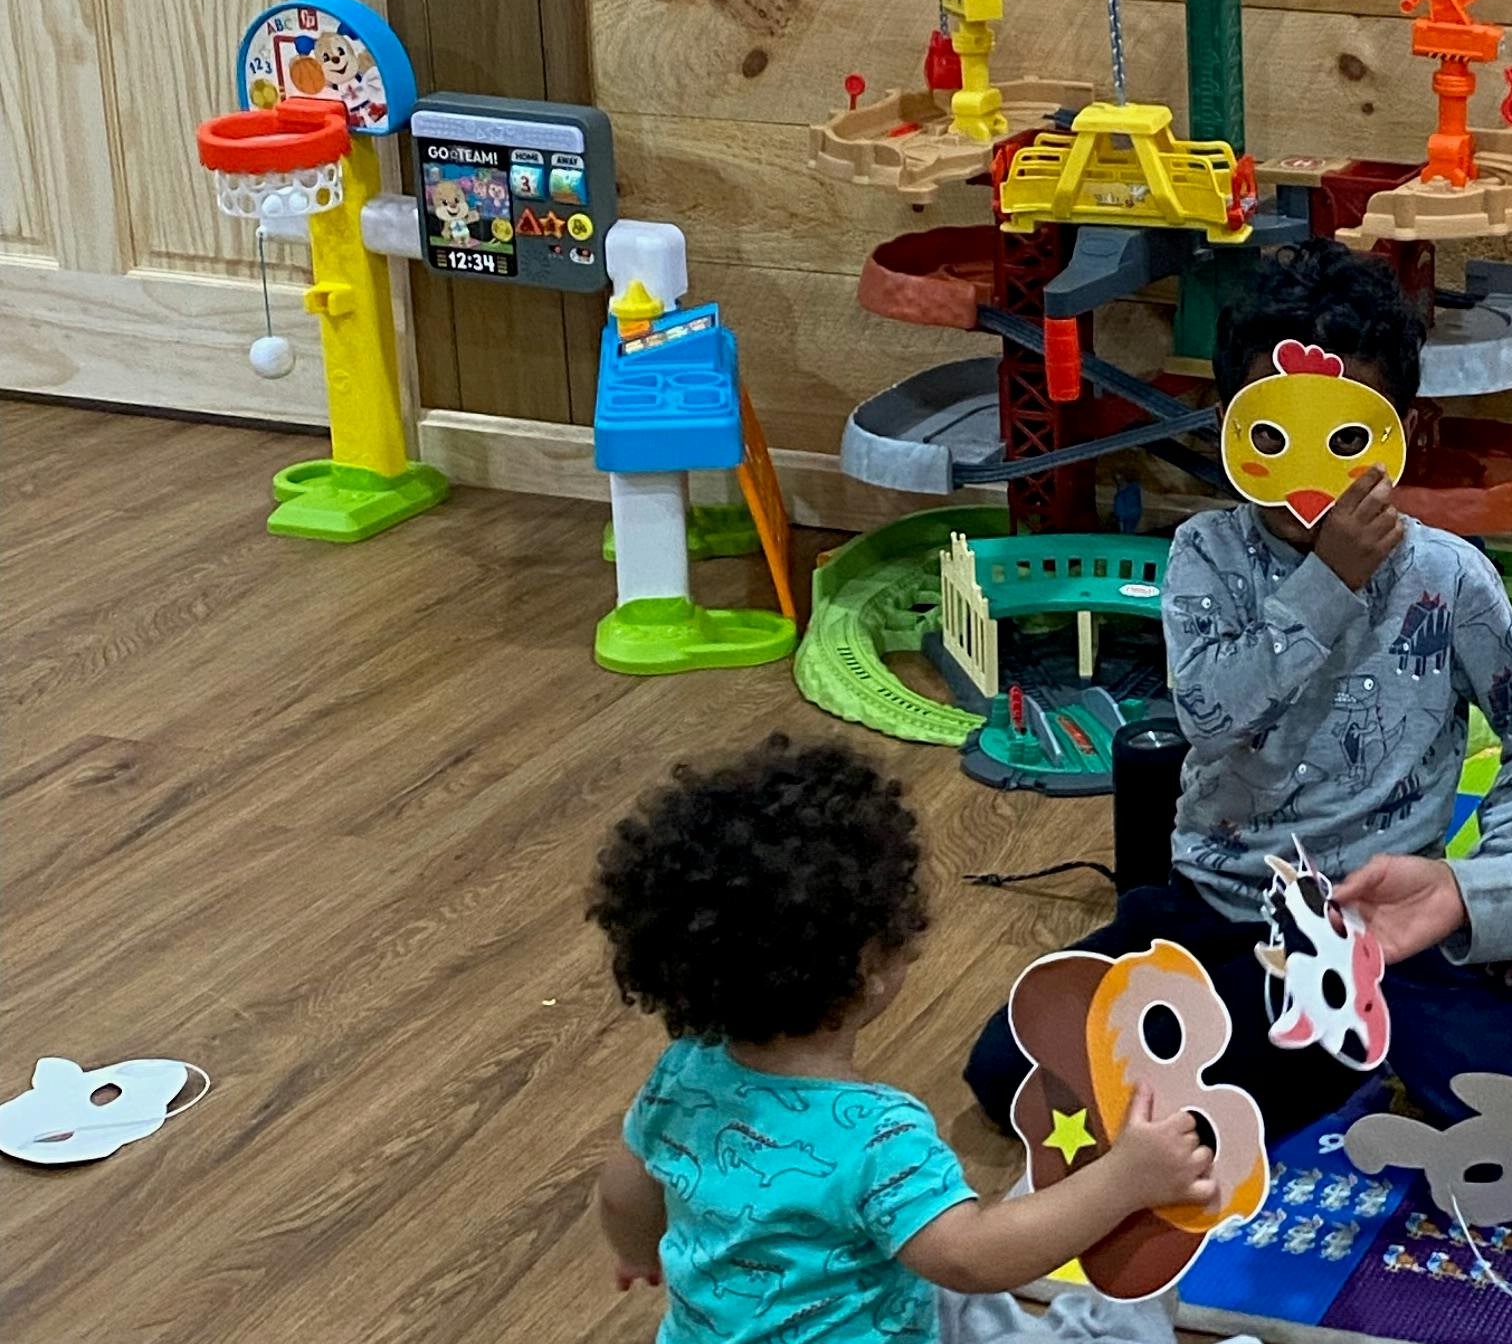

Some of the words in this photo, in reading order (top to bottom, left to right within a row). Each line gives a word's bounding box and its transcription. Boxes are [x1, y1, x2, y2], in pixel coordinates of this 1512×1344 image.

[266, 18, 293, 36] ABC
[250, 57, 273, 74] 123
[427, 146, 449, 160] GO
[456, 147, 499, 166] TEAM!
[556, 156, 579, 166] AWAY
[520, 175, 532, 193] 3
[448, 251, 496, 272] 12:34
